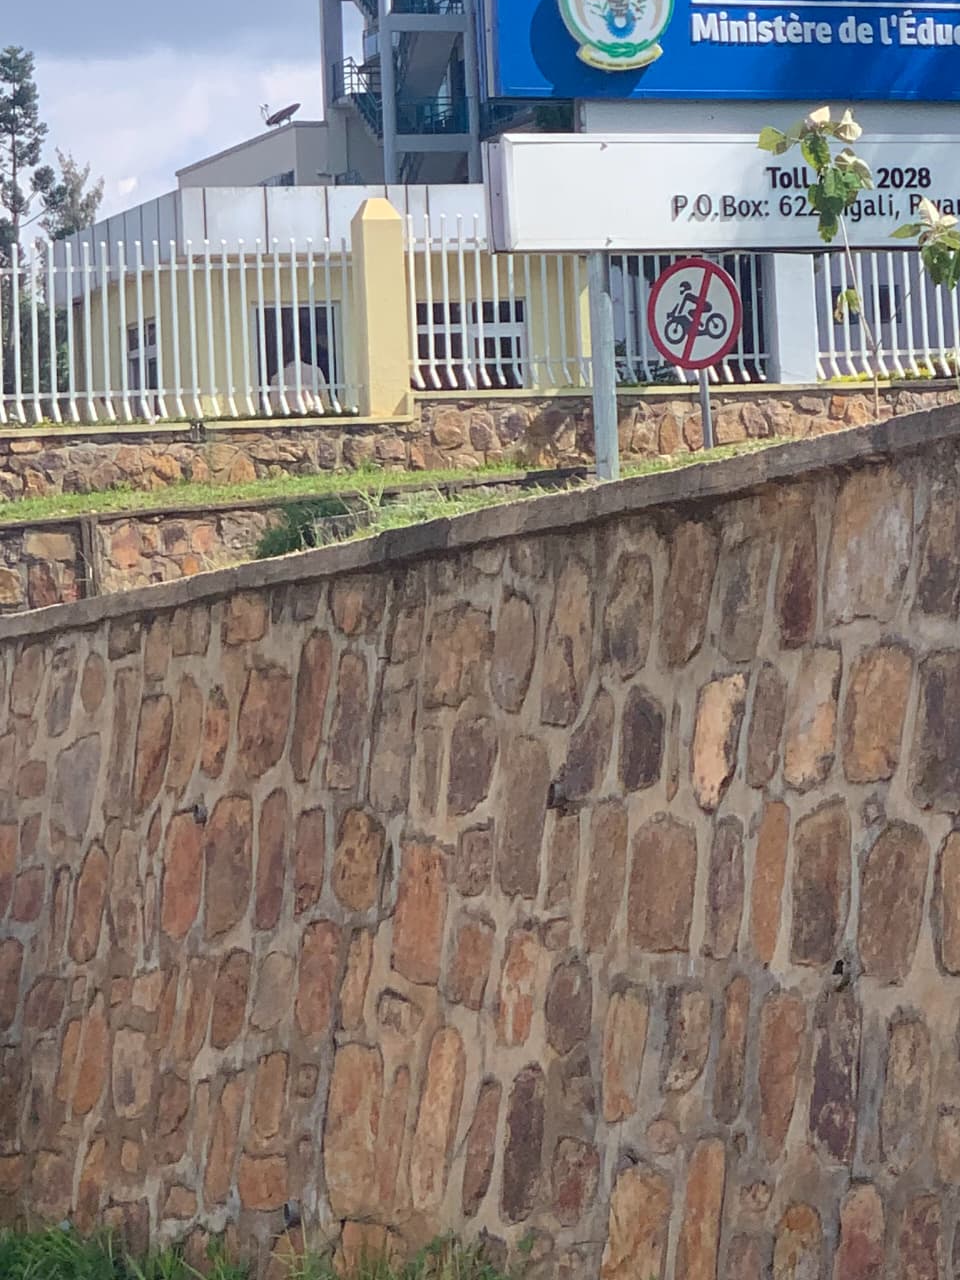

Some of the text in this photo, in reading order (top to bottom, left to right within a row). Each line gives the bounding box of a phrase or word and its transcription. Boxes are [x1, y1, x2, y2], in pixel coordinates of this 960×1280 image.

[691, 11, 832, 44] Ministère
[838, 15, 874, 45] de
[765, 166, 810, 190] Toll
[877, 167, 932, 189] 2028
[836, 194, 900, 222] igali,
